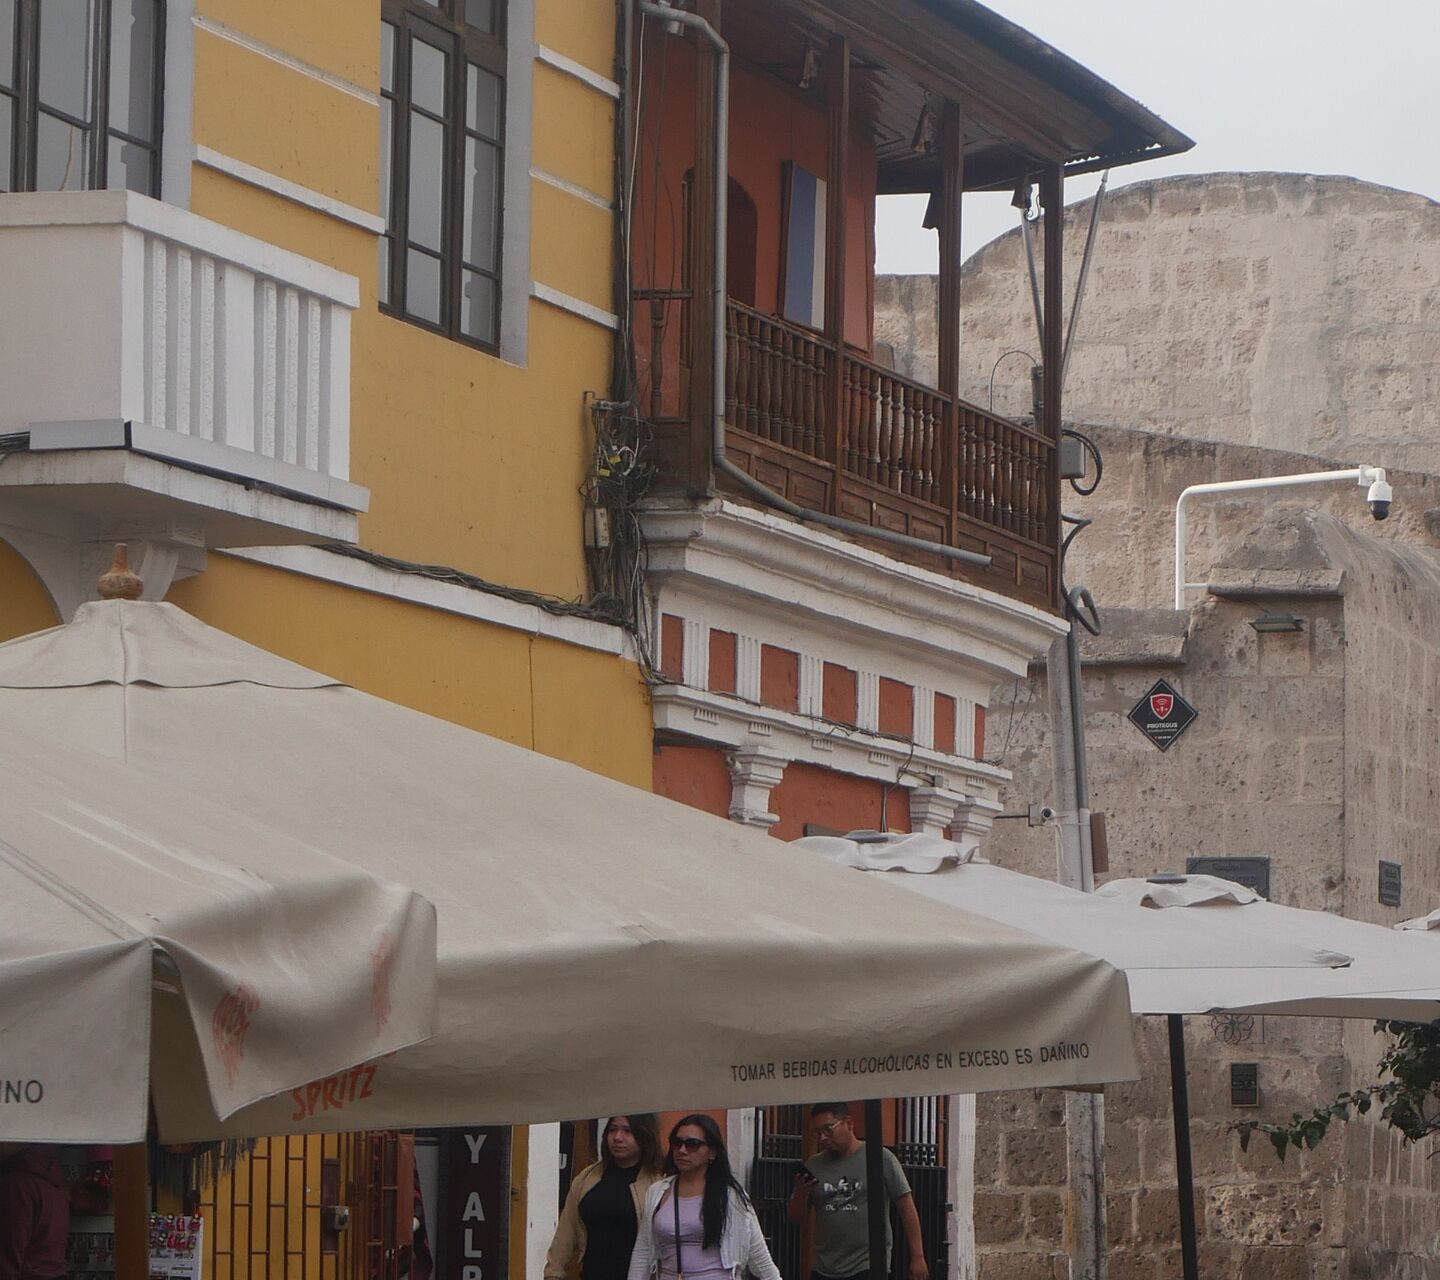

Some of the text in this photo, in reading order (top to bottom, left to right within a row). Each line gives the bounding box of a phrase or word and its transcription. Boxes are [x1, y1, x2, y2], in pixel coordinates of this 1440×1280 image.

[730, 1063, 776, 1082] TOMAR
[783, 1059, 838, 1079] BEBIDAS
[936, 1053, 953, 1069] EN
[959, 1050, 1009, 1068] EXCESO
[1015, 1048, 1033, 1064] ES
[1040, 1042, 1089, 1063] DAÑINO
[292, 1063, 377, 1121] SPRITZ
[464, 1134, 488, 1164] Y
